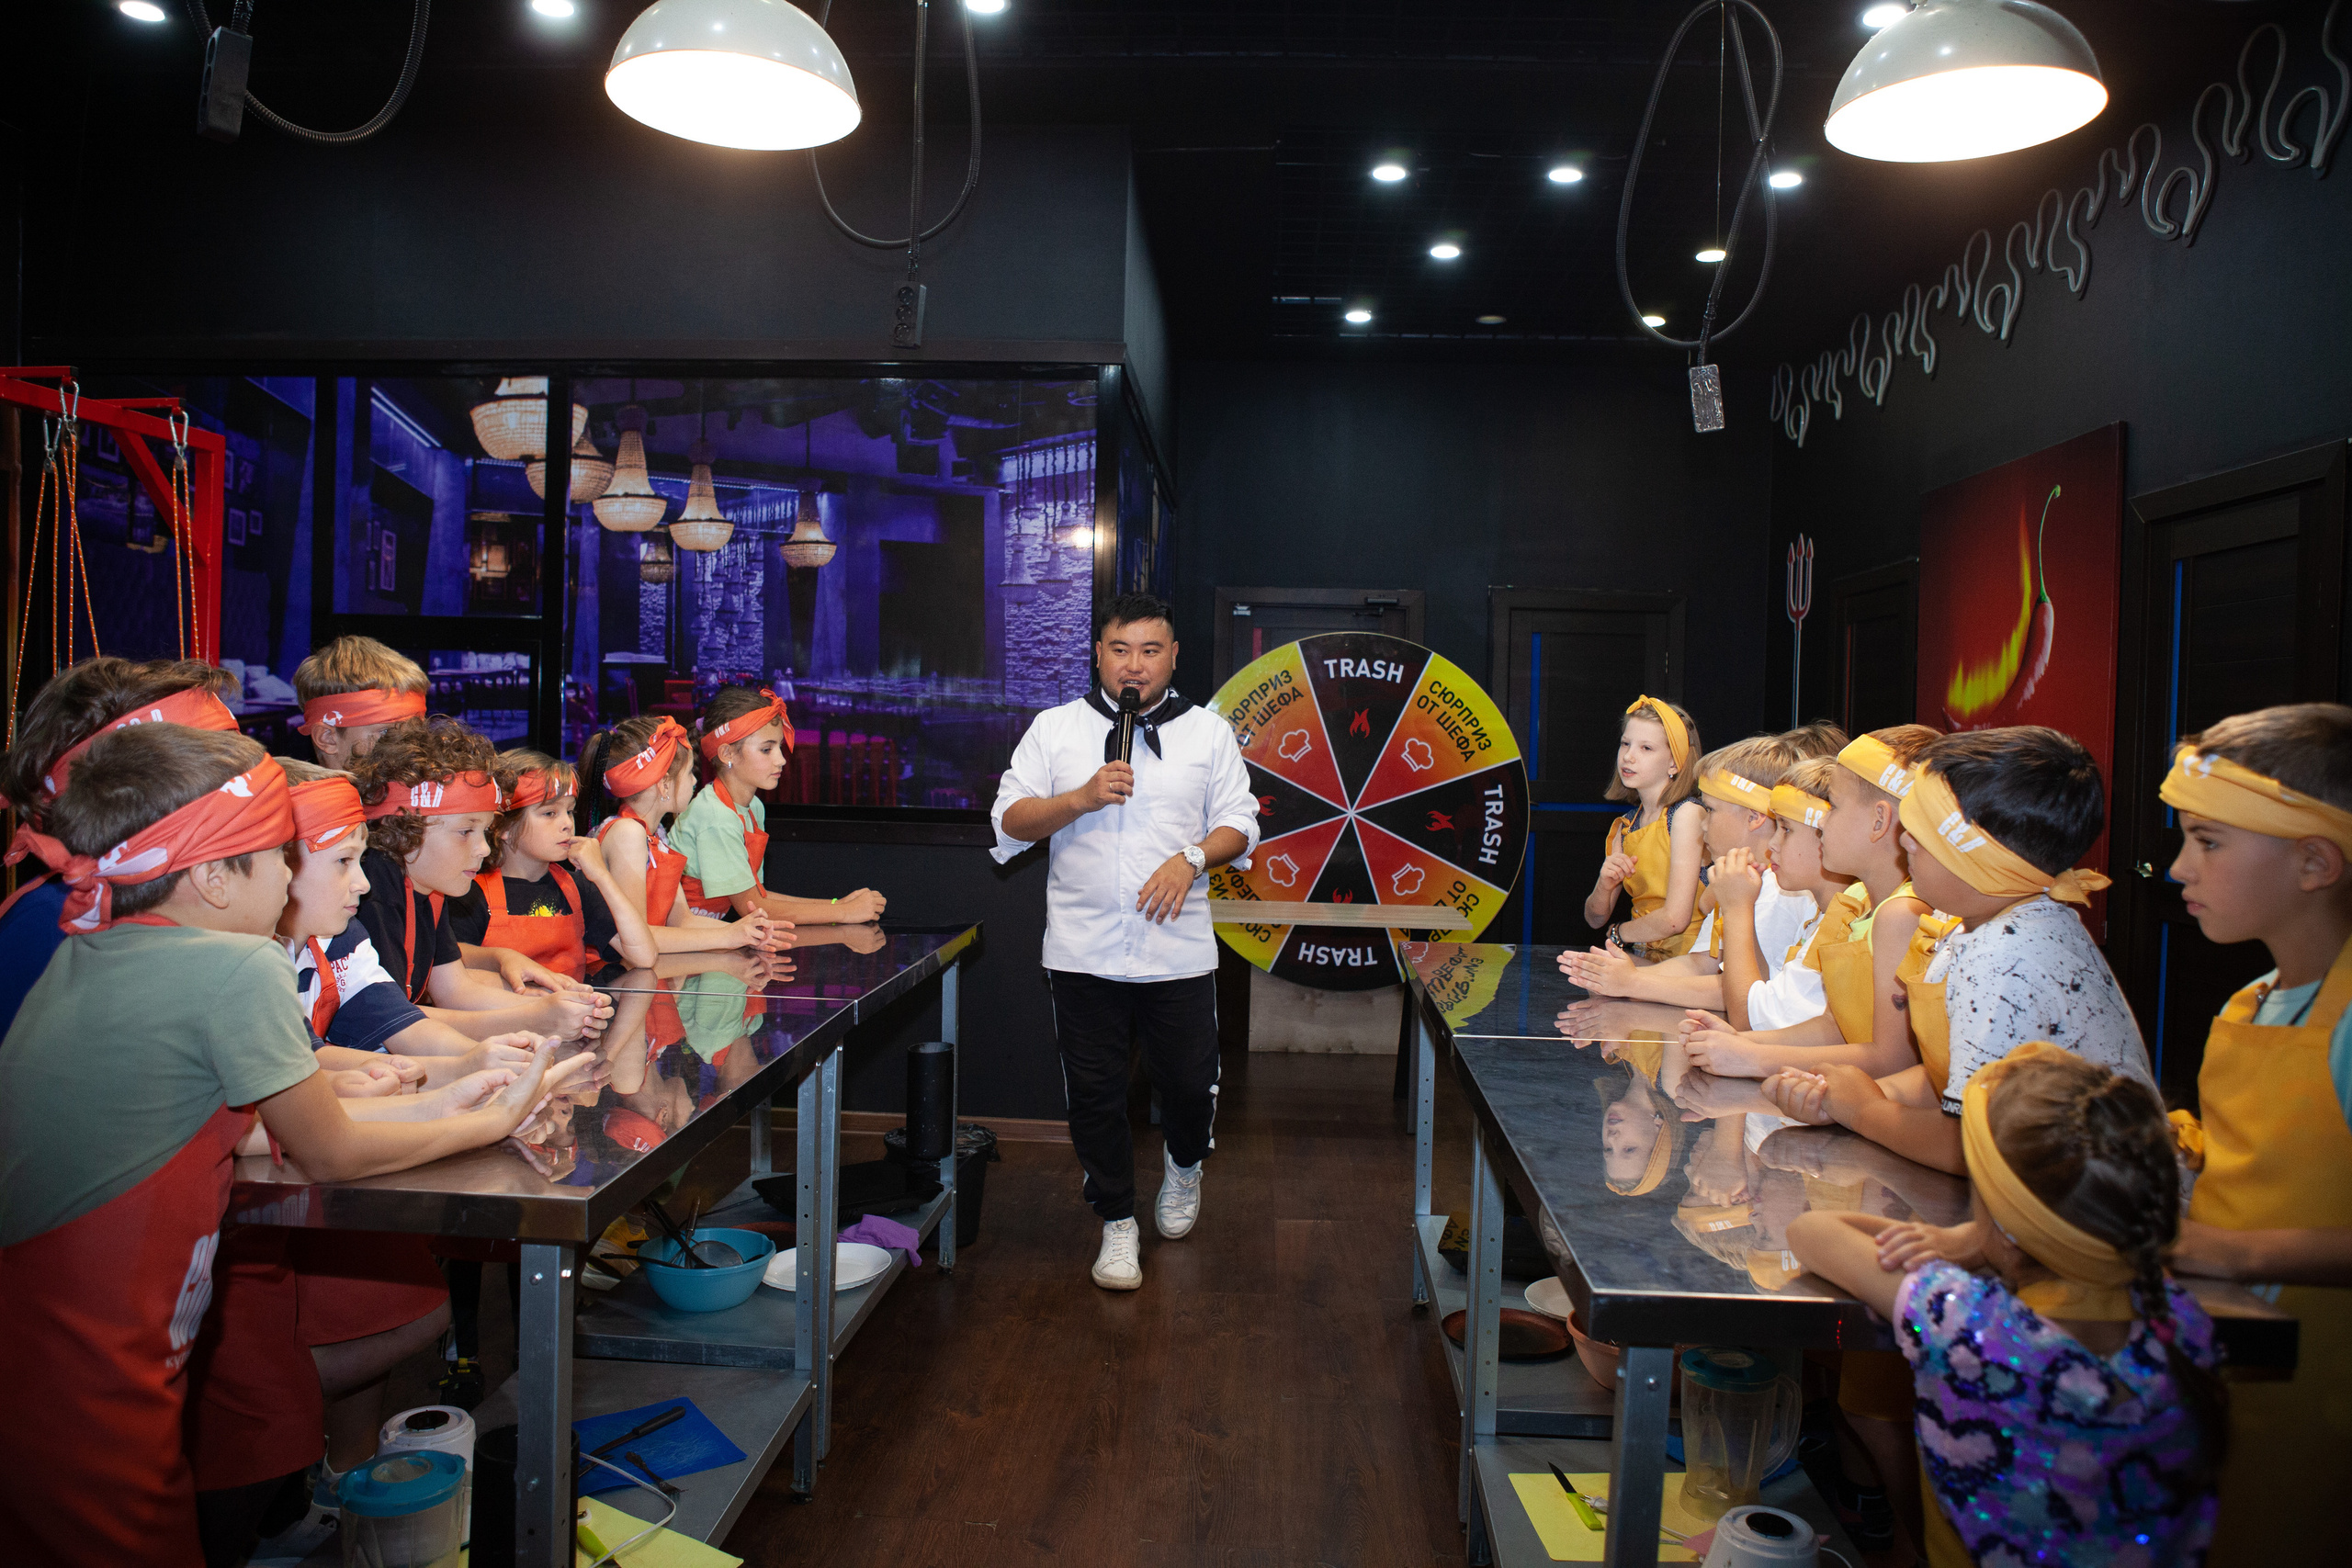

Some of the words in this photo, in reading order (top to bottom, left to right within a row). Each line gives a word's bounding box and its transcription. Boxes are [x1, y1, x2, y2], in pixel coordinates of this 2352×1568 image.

[1228, 670, 1293, 732] ЮРПРИЗ
[1324, 659, 1404, 683] TRASH
[1237, 724, 1256, 746] ОТ
[1252, 686, 1304, 727] ШЕФА
[1417, 695, 1440, 715] ОТ
[1436, 711, 1476, 762] ШЕФА
[1430, 681, 1491, 750] СЮРПРИЗ
[1478, 784, 1503, 864] TRASH
[1447, 881, 1466, 904] ОТ
[1298, 942, 1377, 966] TRASH
